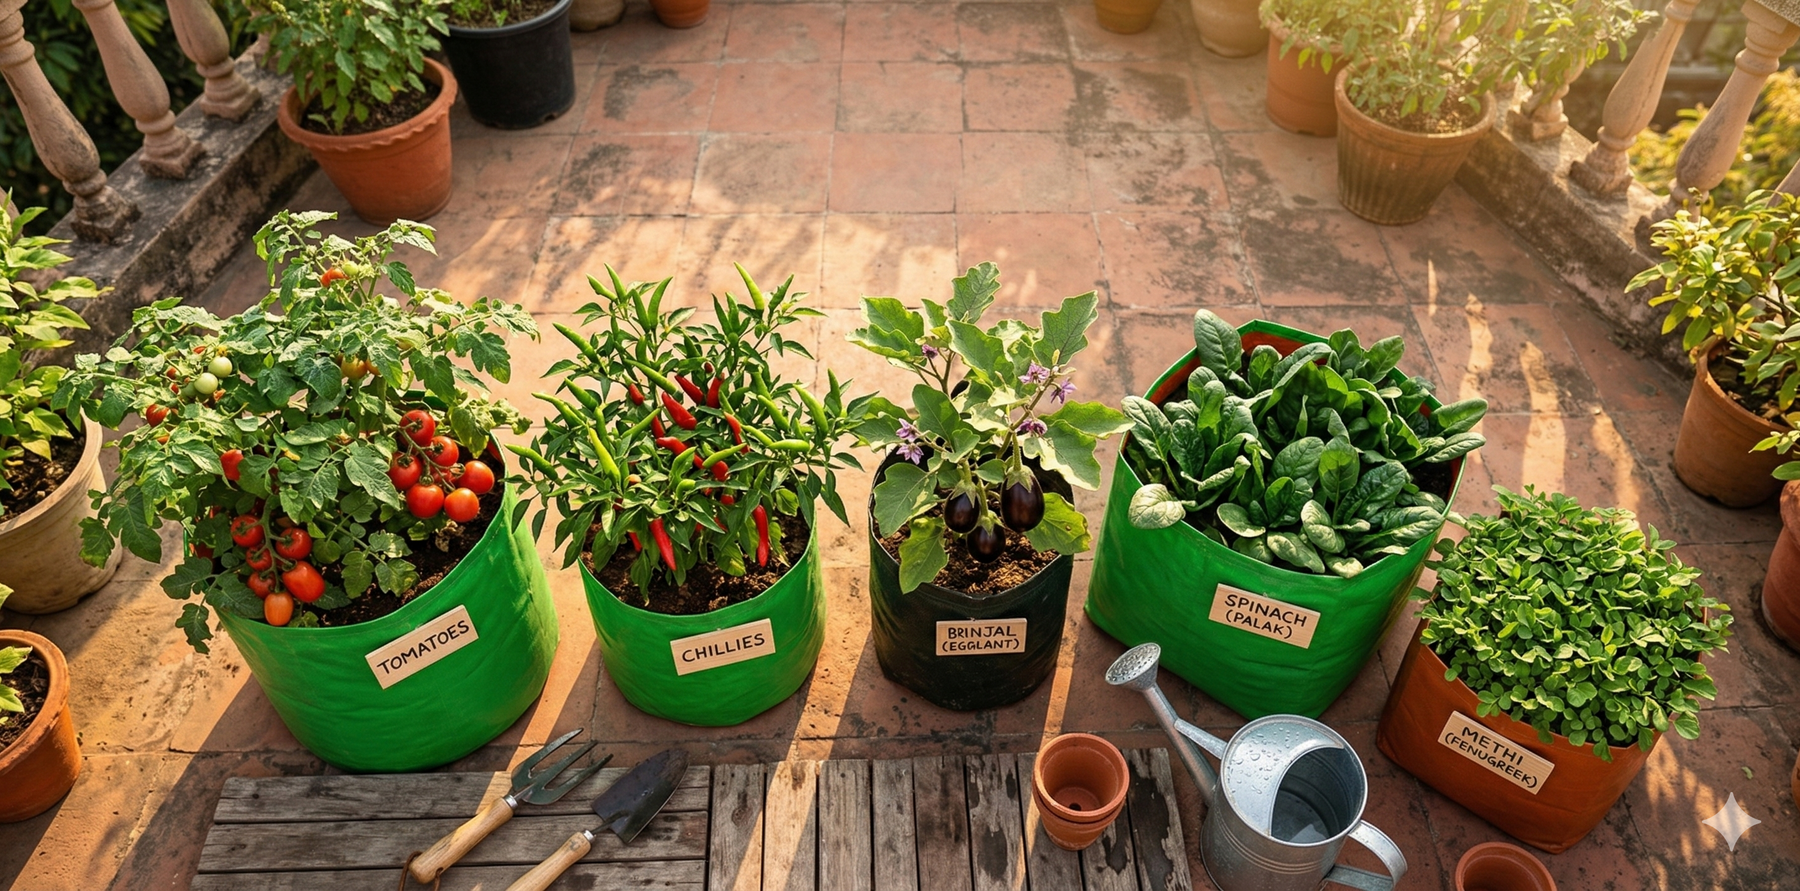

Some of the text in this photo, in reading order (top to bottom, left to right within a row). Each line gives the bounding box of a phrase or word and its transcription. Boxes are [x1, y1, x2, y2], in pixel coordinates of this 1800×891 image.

[1224, 594, 1308, 627] SPINACH
[1225, 609, 1293, 639] (PALAK)
[376, 620, 470, 674] TOMATOES
[681, 633, 765, 662] CHILLIES
[942, 638, 1020, 652] (EGGLANT)
[948, 625, 1017, 639] BRINJAL
[1444, 732, 1538, 789] (FENUGREEK)
[1461, 726, 1524, 766] METHI
